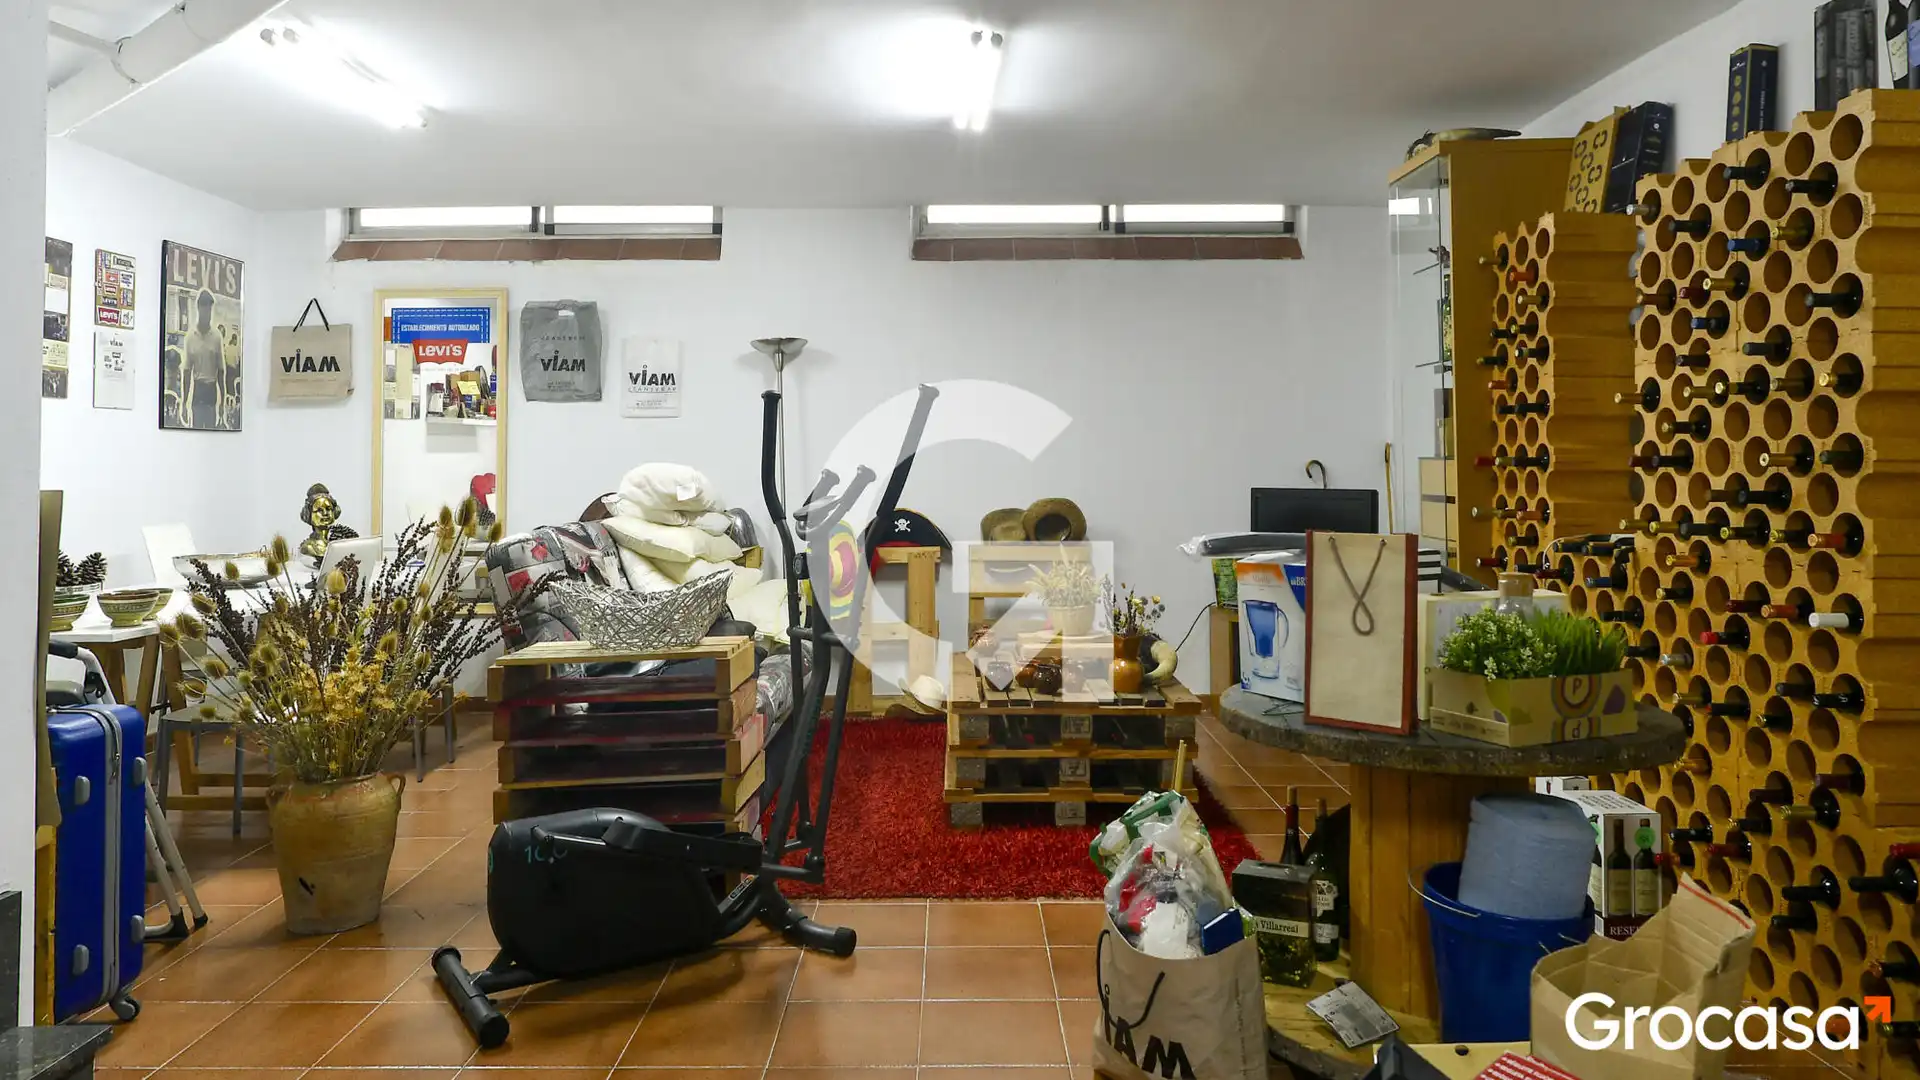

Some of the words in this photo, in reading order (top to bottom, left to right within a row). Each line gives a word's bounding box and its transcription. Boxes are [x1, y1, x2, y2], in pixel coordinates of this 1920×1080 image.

[173, 249, 237, 295] LEVI'S
[448, 324, 480, 332] AUTORIZADO
[1260, 920, 1299, 933] Villarreal
[1610, 926, 1639, 936] RESE
